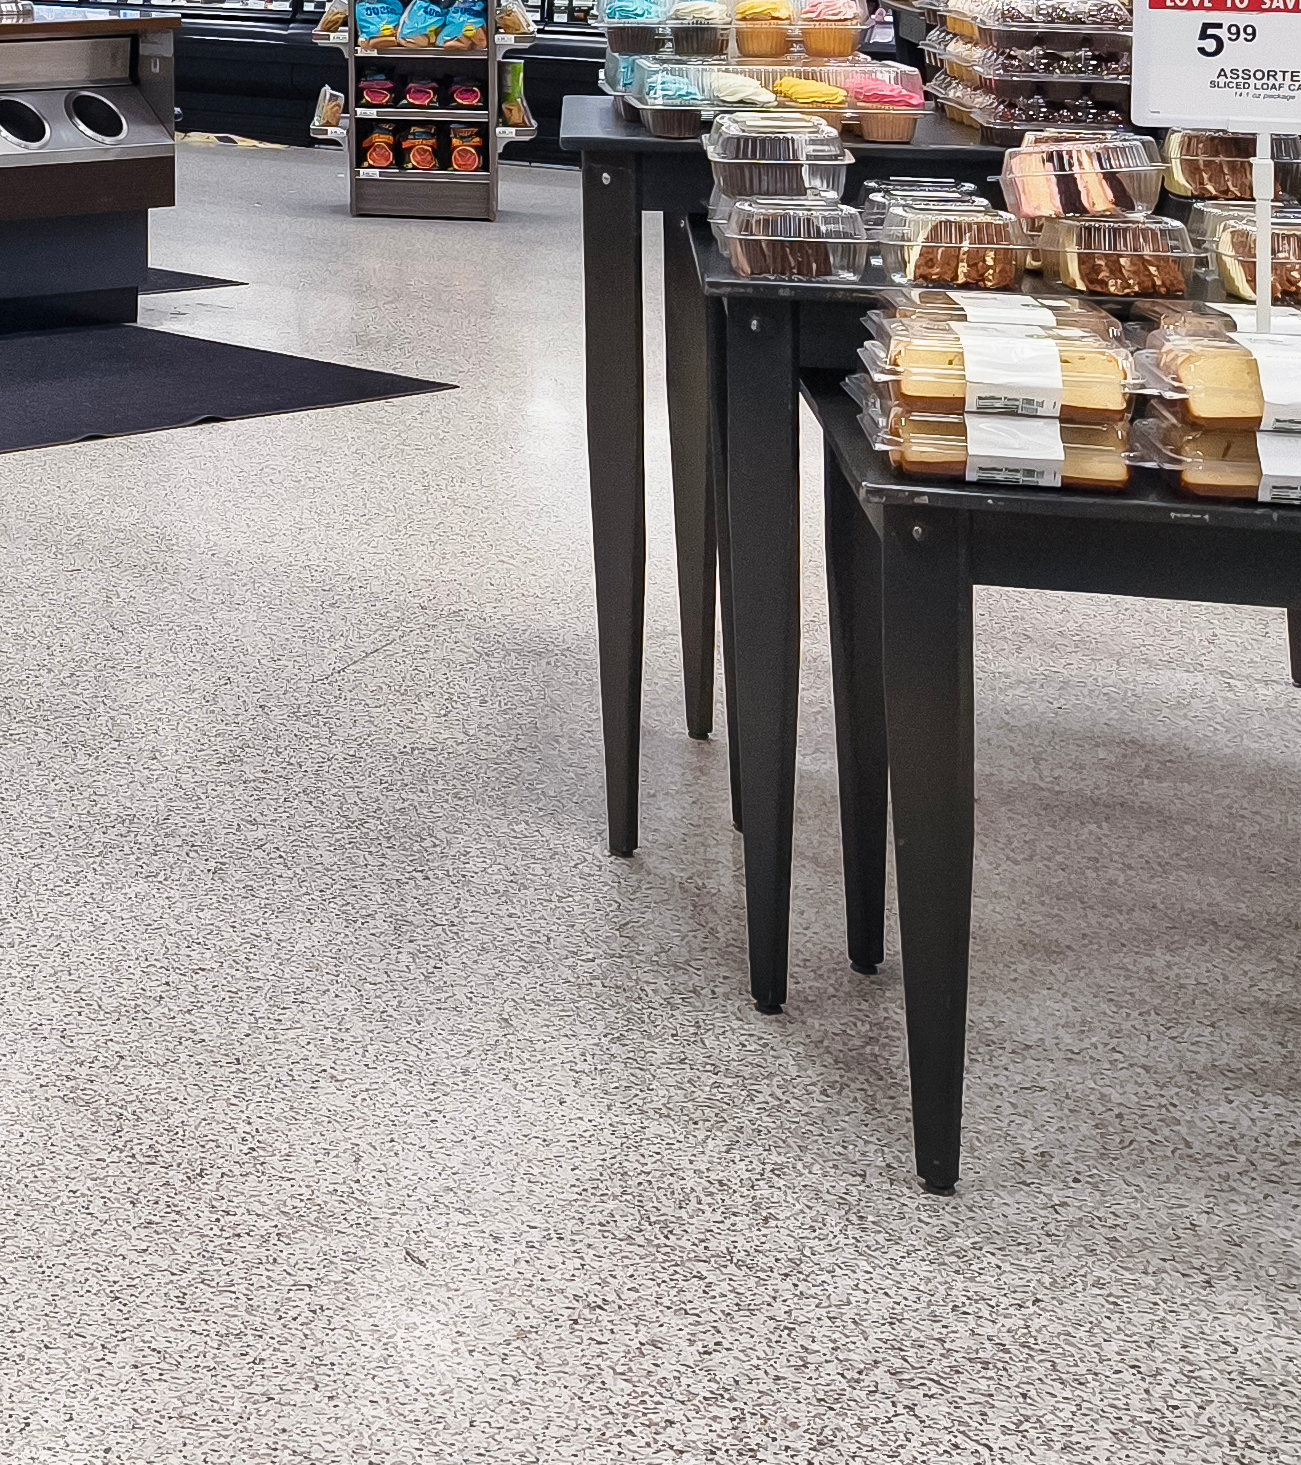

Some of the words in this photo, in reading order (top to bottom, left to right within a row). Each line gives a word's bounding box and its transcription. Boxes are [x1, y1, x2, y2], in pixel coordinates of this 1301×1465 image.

[1196, 21, 1257, 58] 599
[1209, 79, 1251, 90] SLICED
[1254, 81, 1285, 91] LOAF
